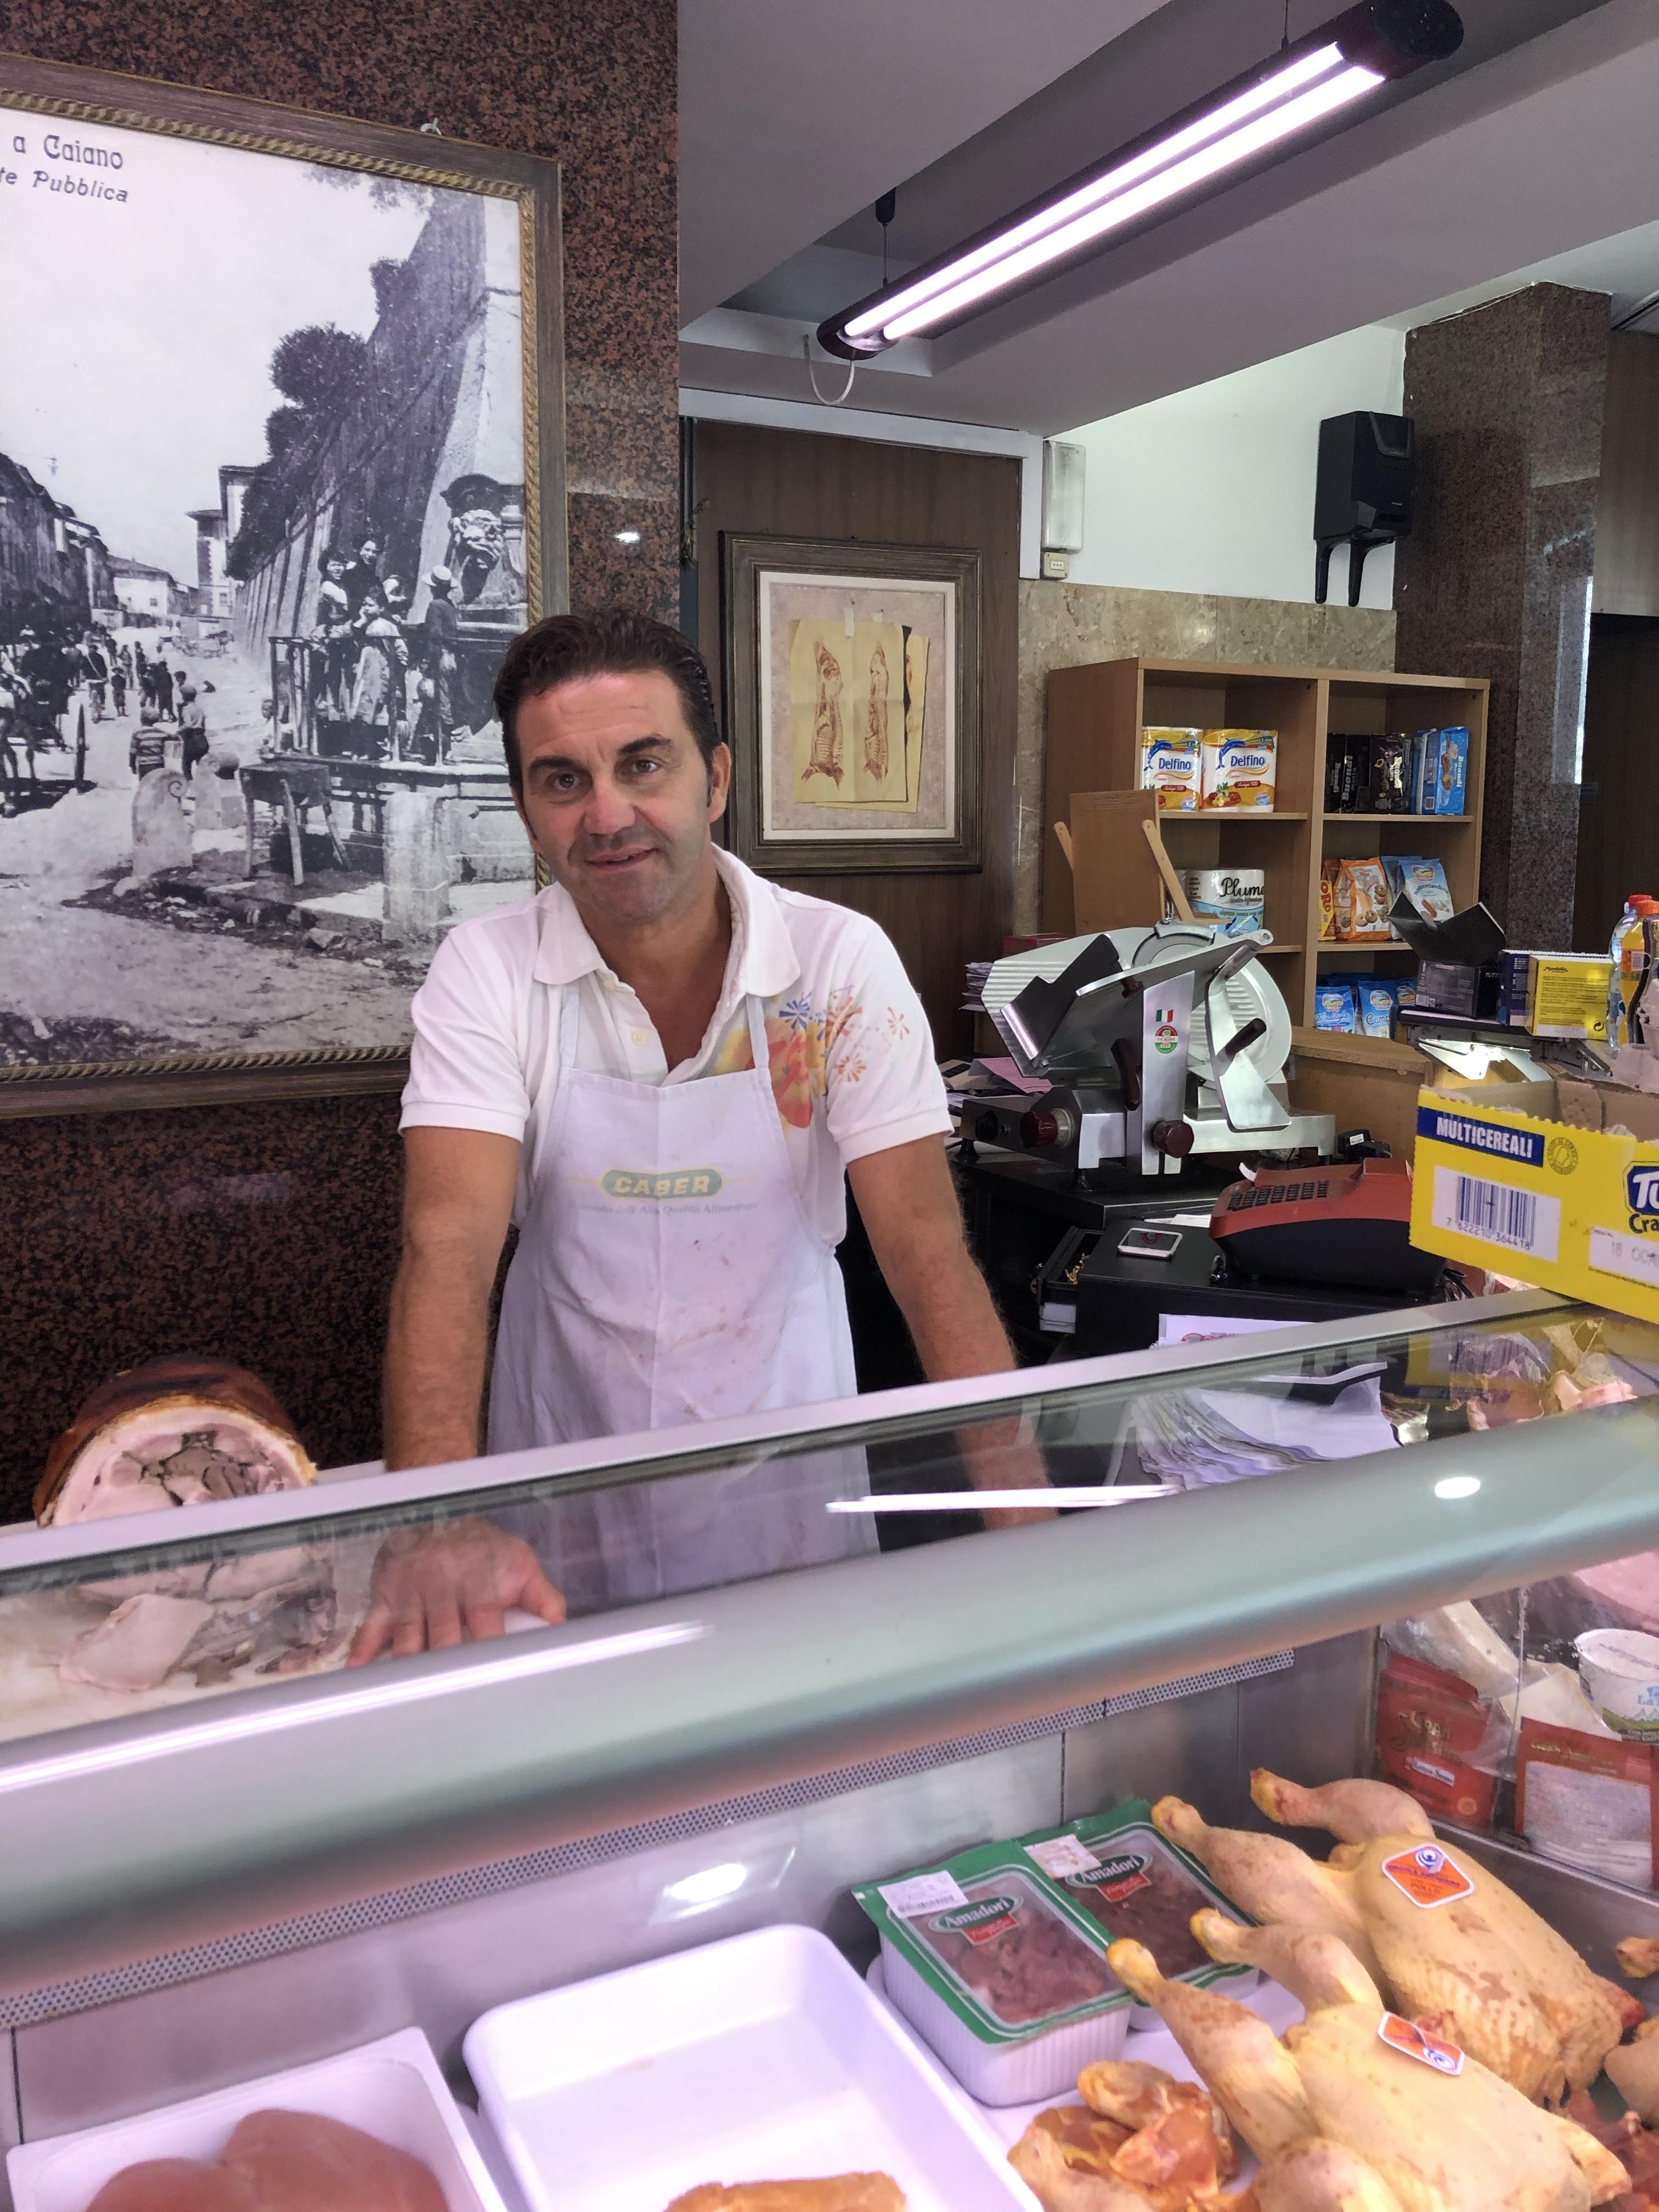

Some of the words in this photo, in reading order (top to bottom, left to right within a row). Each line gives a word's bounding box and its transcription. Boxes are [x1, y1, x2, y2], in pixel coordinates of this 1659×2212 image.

[13, 135, 26, 154] a
[43, 134, 124, 170] Caiano
[32, 170, 129, 202] Pubblica
[1158, 757, 1192, 770] Delfino
[1231, 754, 1266, 767] Delfino
[1436, 1116, 1533, 1159] MULTICEREALI
[614, 1176, 710, 1196] CABER
[1628, 1212, 1659, 1234] Cra
[1077, 1855, 1141, 1883] Amadori
[944, 1897, 1011, 1928] Amadori
